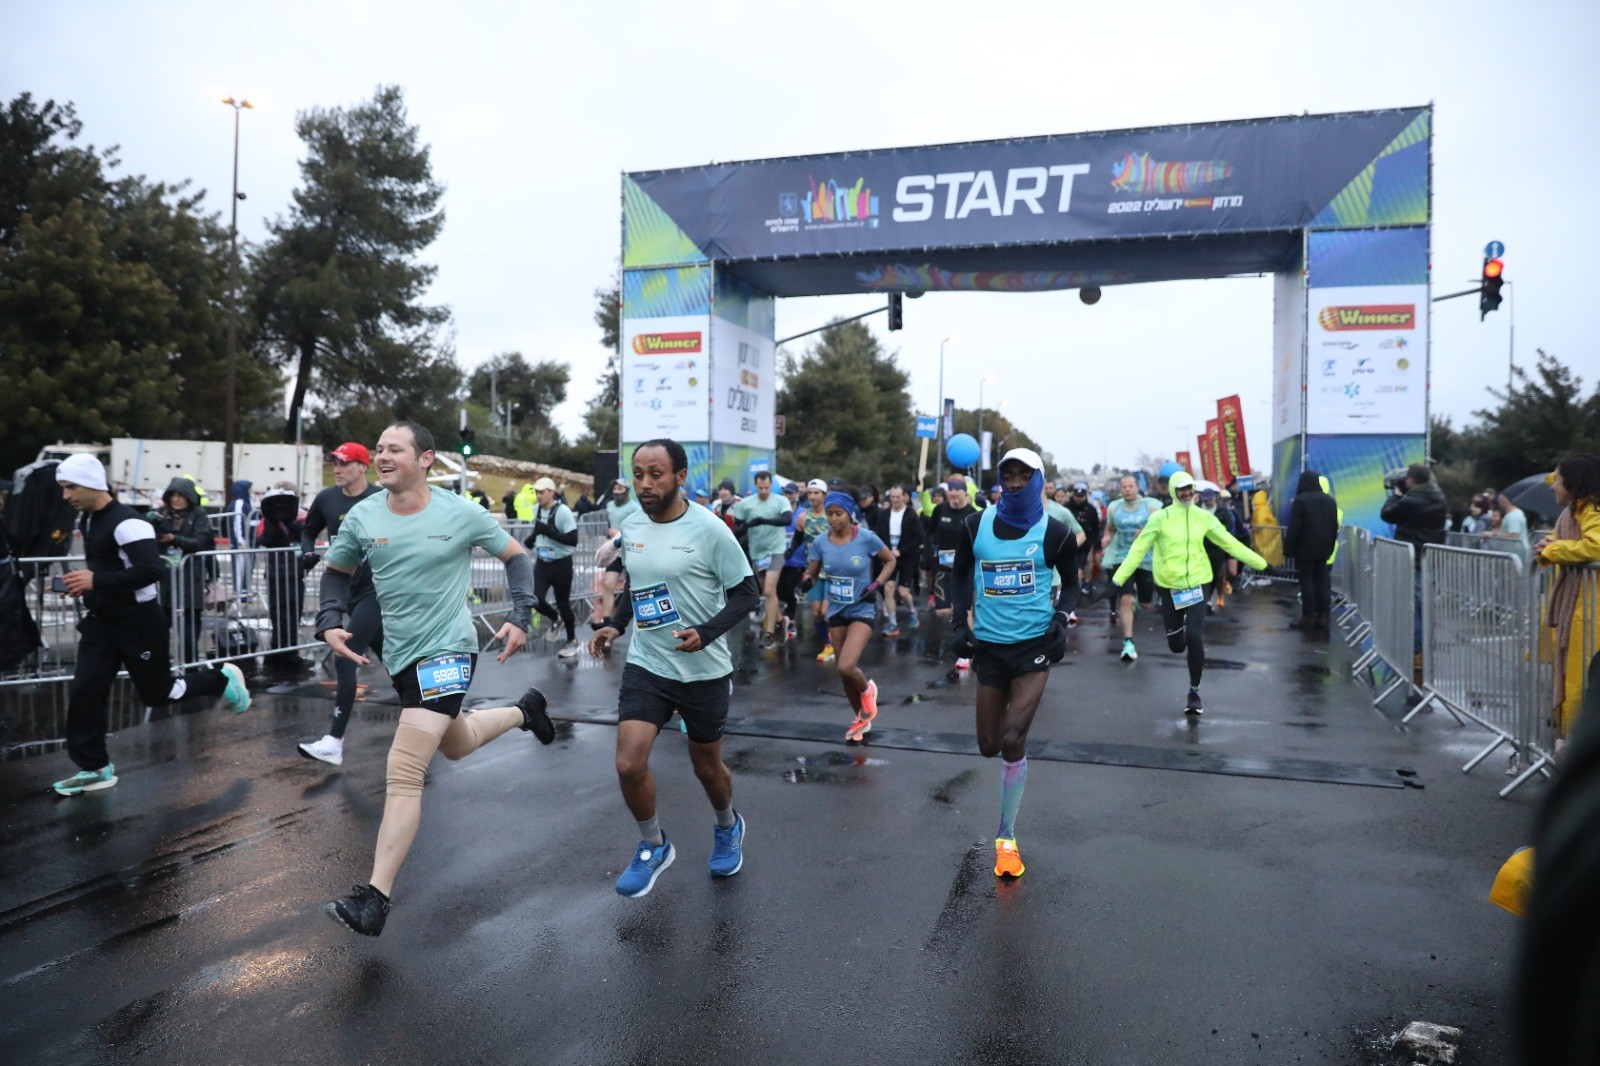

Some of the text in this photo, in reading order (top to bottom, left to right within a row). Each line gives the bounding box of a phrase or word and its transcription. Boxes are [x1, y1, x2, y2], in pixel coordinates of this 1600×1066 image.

[892, 163, 1090, 222] START
[1107, 201, 1142, 213] 2022
[1143, 198, 1183, 212] ירושלים
[1211, 195, 1243, 211] מרתון
[1338, 309, 1411, 325] Winner
[646, 334, 699, 350] Winner
[994, 574, 1016, 586] 4237
